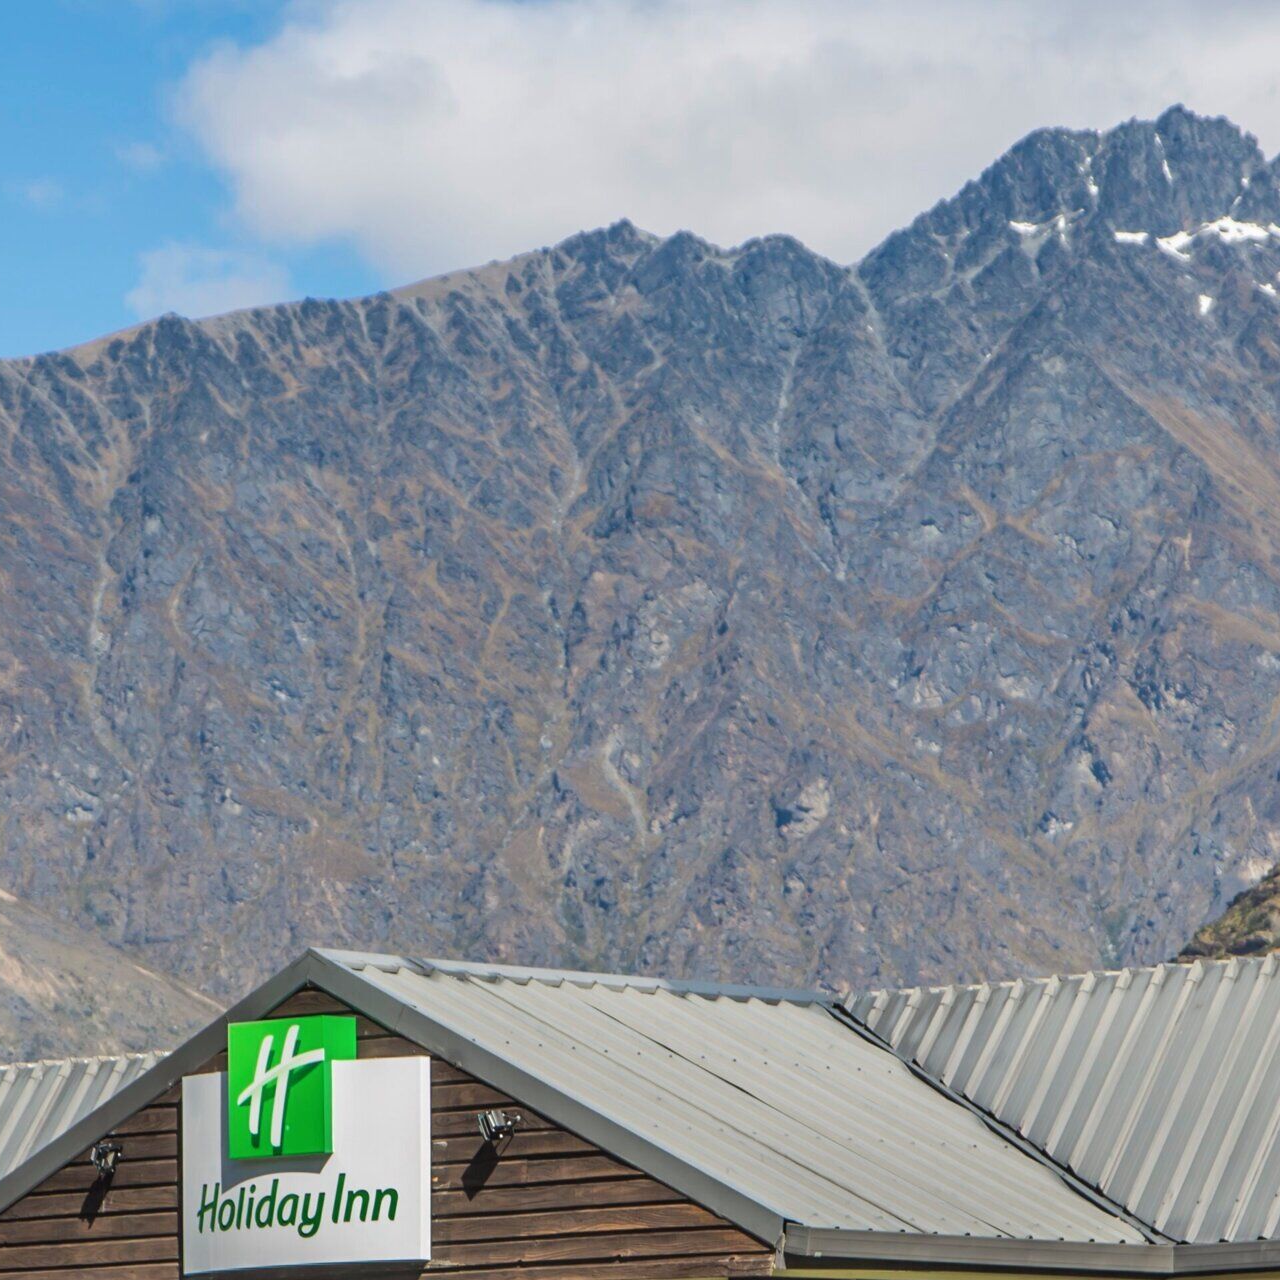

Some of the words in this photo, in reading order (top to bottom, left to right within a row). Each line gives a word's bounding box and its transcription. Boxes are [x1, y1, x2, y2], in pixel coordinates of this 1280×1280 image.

[237, 1024, 325, 1147] H
[197, 1178, 325, 1238] Holiday
[331, 1173, 399, 1223] Inn
